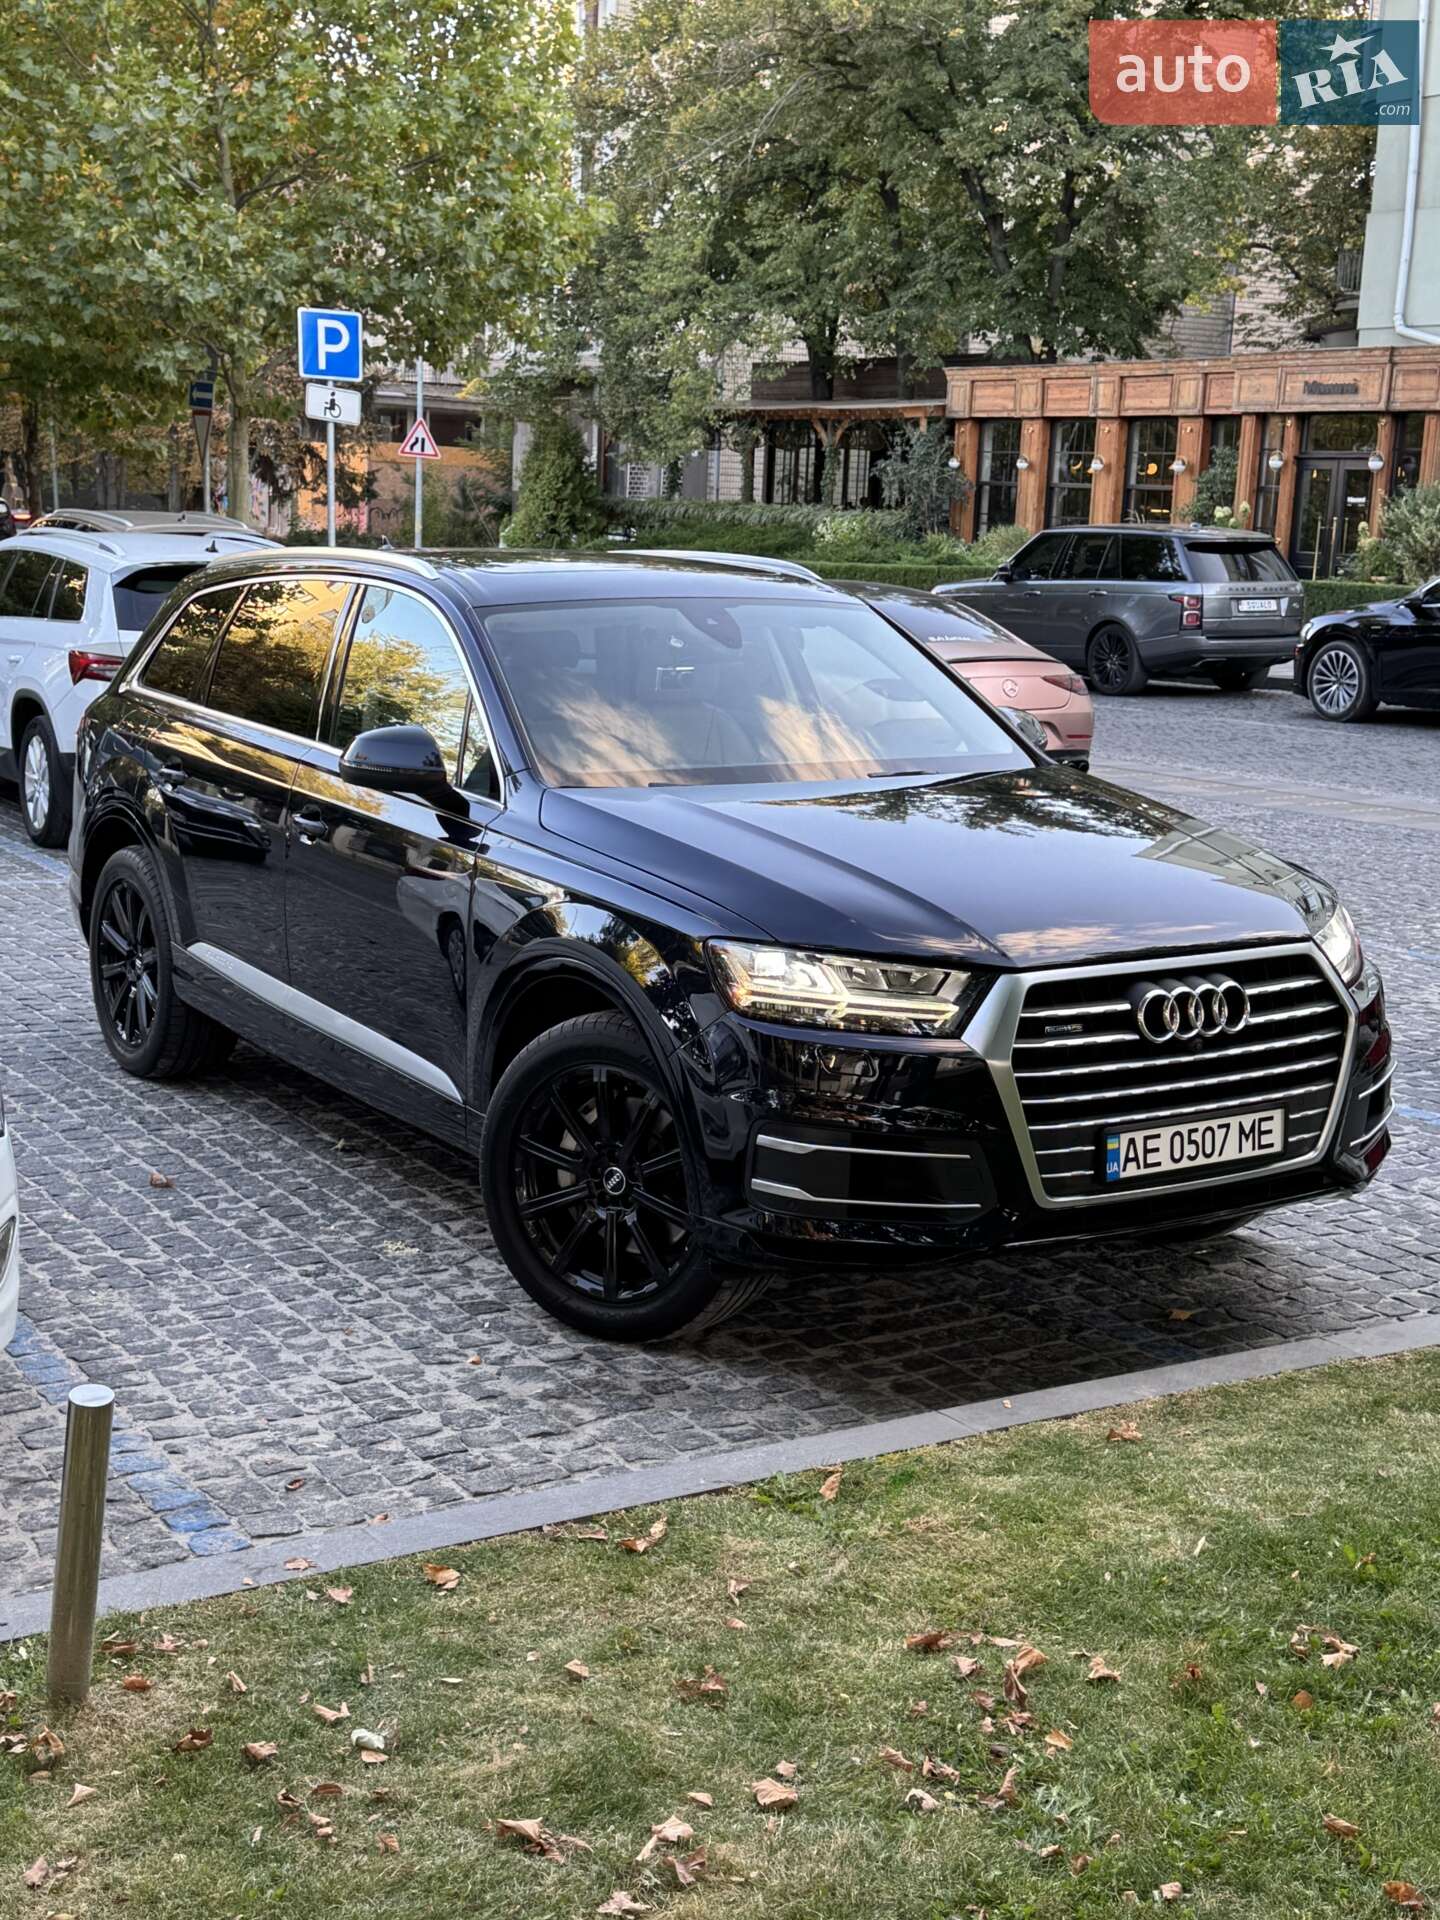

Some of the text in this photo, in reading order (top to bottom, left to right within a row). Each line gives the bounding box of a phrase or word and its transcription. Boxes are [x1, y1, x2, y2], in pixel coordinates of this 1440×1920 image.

[316, 318, 350, 370] P
[1106, 1161, 1119, 1173] UA
[1122, 1115, 1274, 1172] AE 0507 ME
